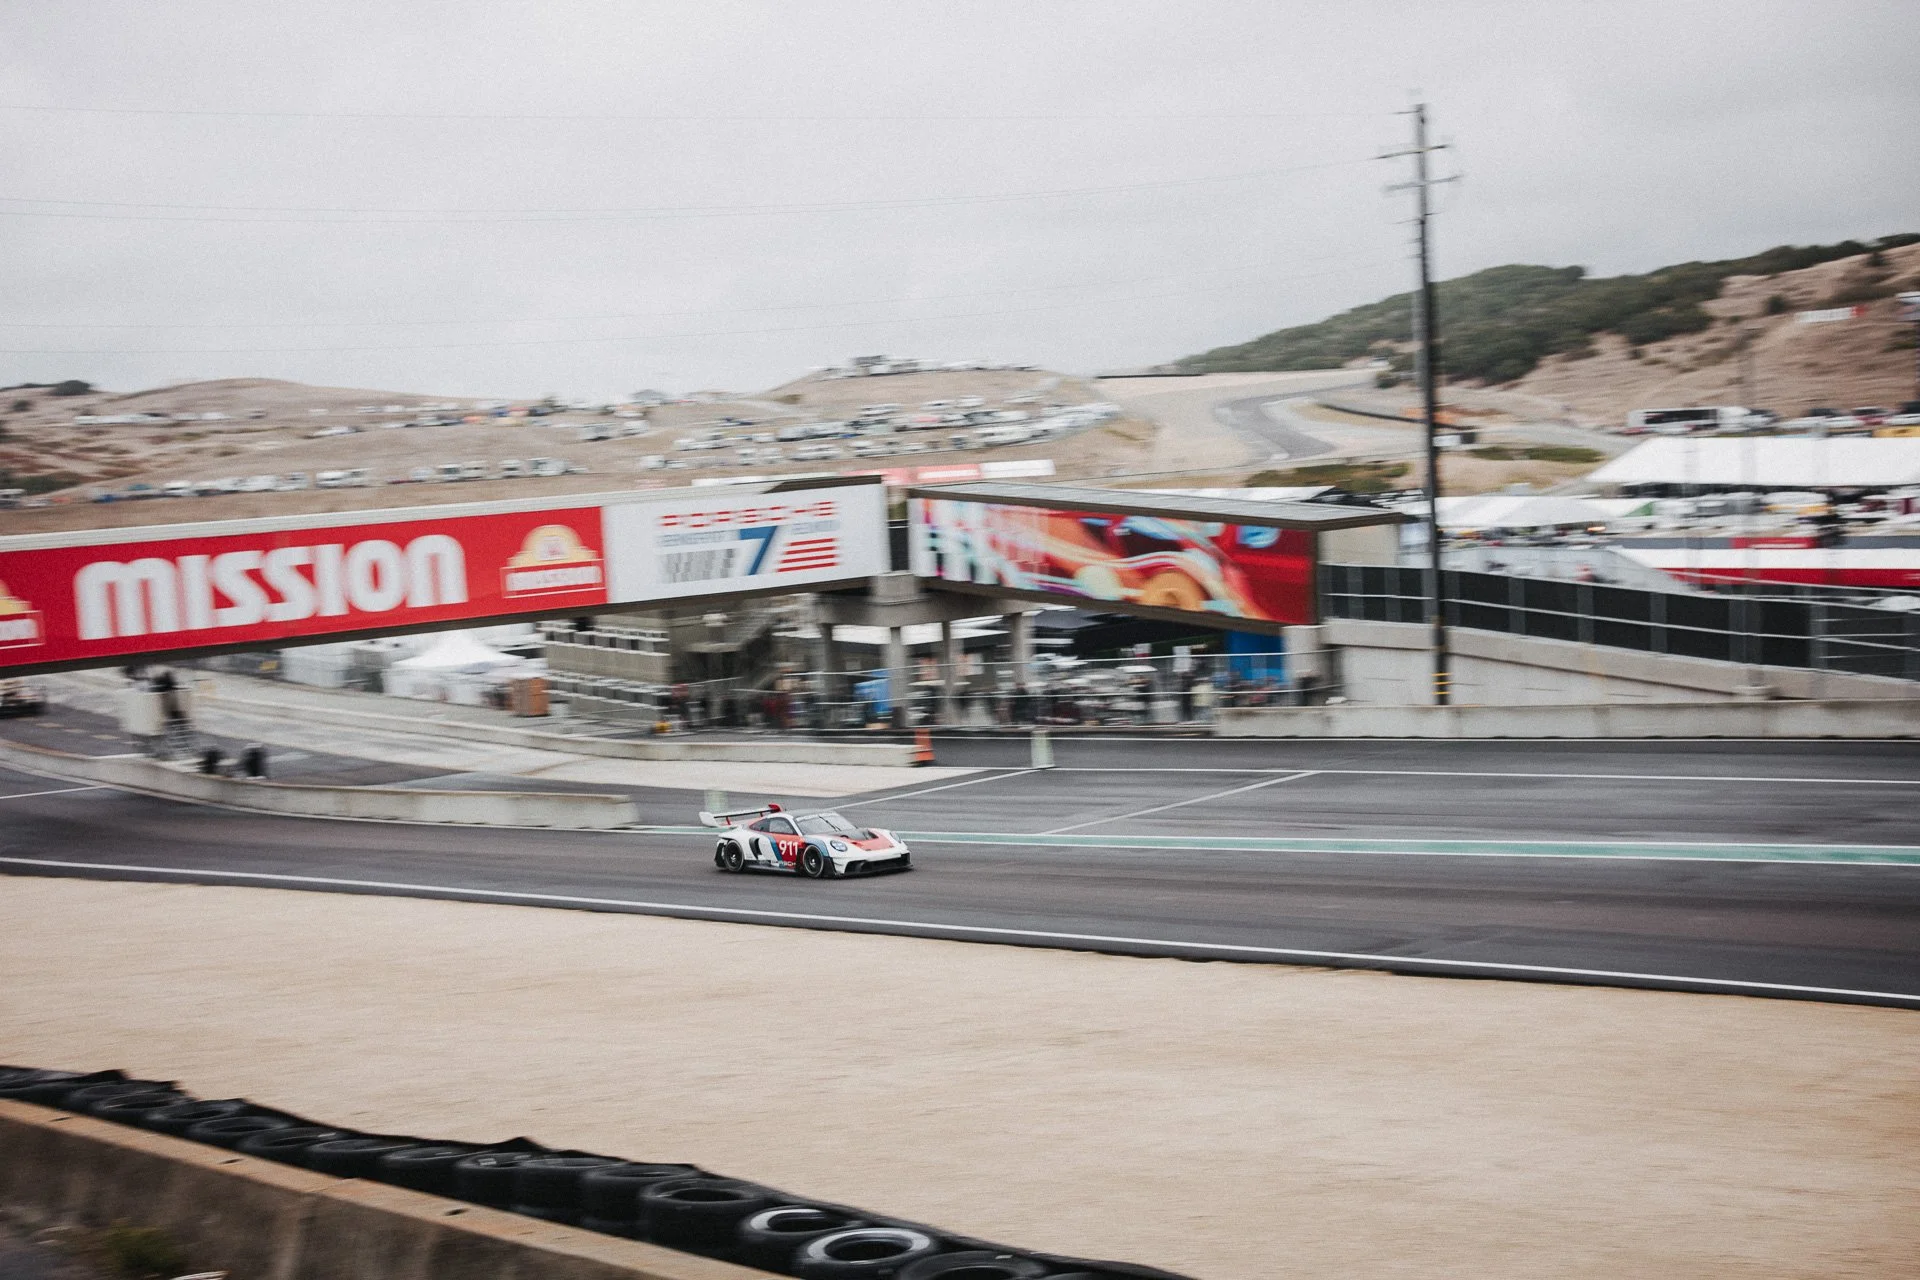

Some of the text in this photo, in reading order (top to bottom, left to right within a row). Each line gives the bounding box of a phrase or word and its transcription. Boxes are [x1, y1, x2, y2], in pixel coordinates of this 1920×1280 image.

[738, 525, 779, 576] 7
[73, 534, 468, 640] MISSION
[778, 839, 799, 856] 911
